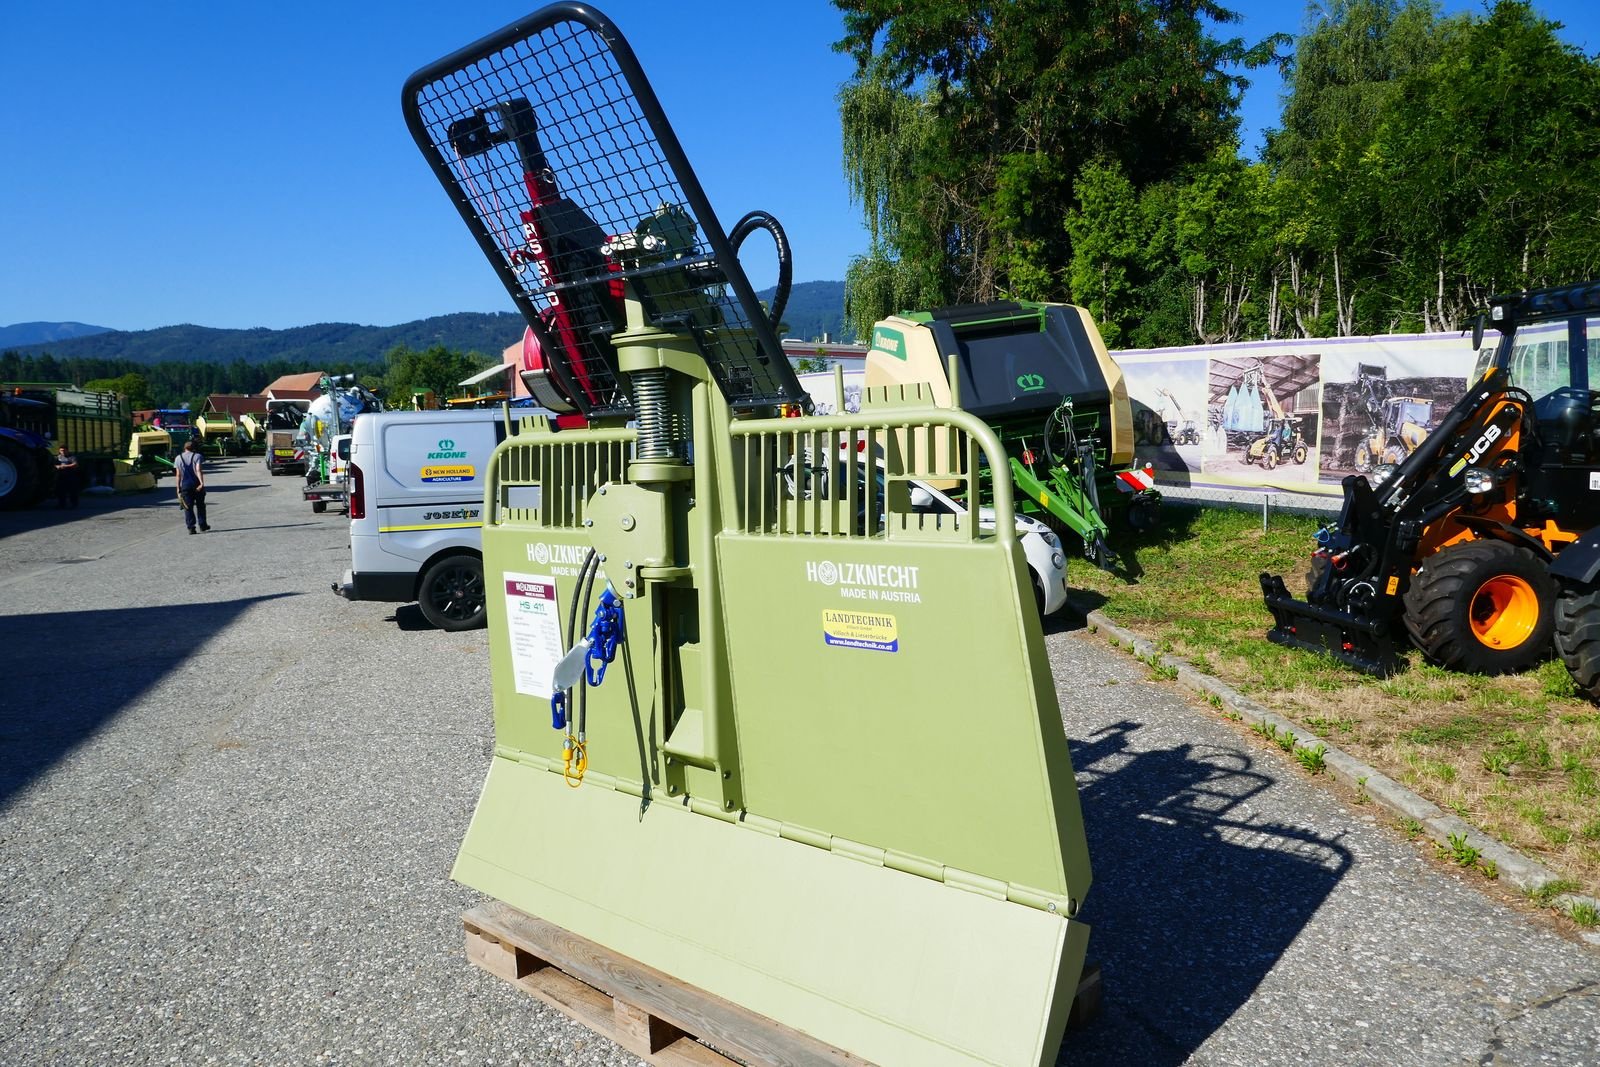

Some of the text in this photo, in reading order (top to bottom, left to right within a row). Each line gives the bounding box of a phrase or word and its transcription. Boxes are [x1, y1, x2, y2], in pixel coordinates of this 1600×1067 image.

[1468, 424, 1502, 464] JCB
[427, 451, 467, 459] KRONE
[551, 566, 569, 576] MADE
[570, 568, 578, 577] IN
[806, 560, 919, 589] HOLZKNECHT
[840, 588, 921, 603] MADE IN AUSTRIA
[519, 600, 545, 612] HS 411
[825, 612, 893, 628] LANDTECHNIK
[829, 639, 893, 650] www.landtechnik.co.at
